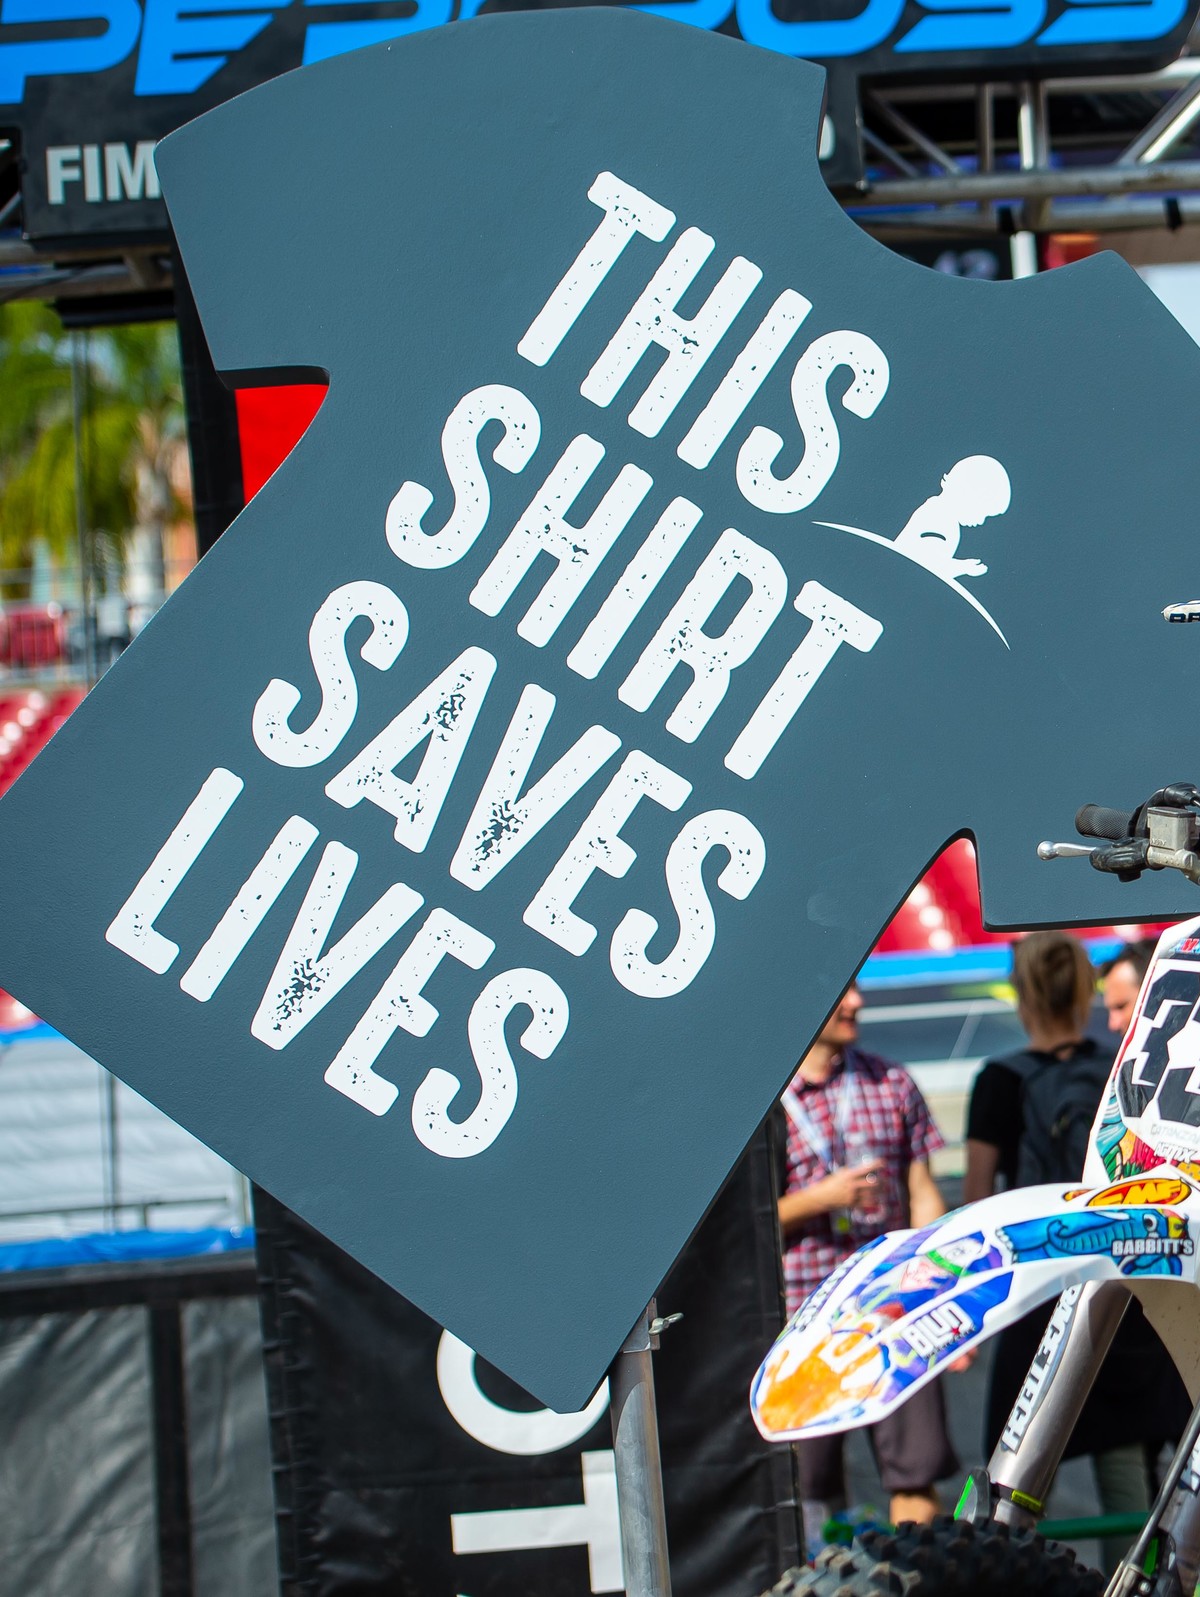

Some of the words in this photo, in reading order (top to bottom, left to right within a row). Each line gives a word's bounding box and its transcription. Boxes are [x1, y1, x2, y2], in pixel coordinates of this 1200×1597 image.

[46, 140, 162, 206] FIM
[517, 171, 891, 514] THIS
[384, 384, 885, 780] SHIRT
[104, 766, 570, 1158] LIVES
[251, 580, 767, 999] SAVES
[1112, 1238, 1195, 1257] BABBITT'S
